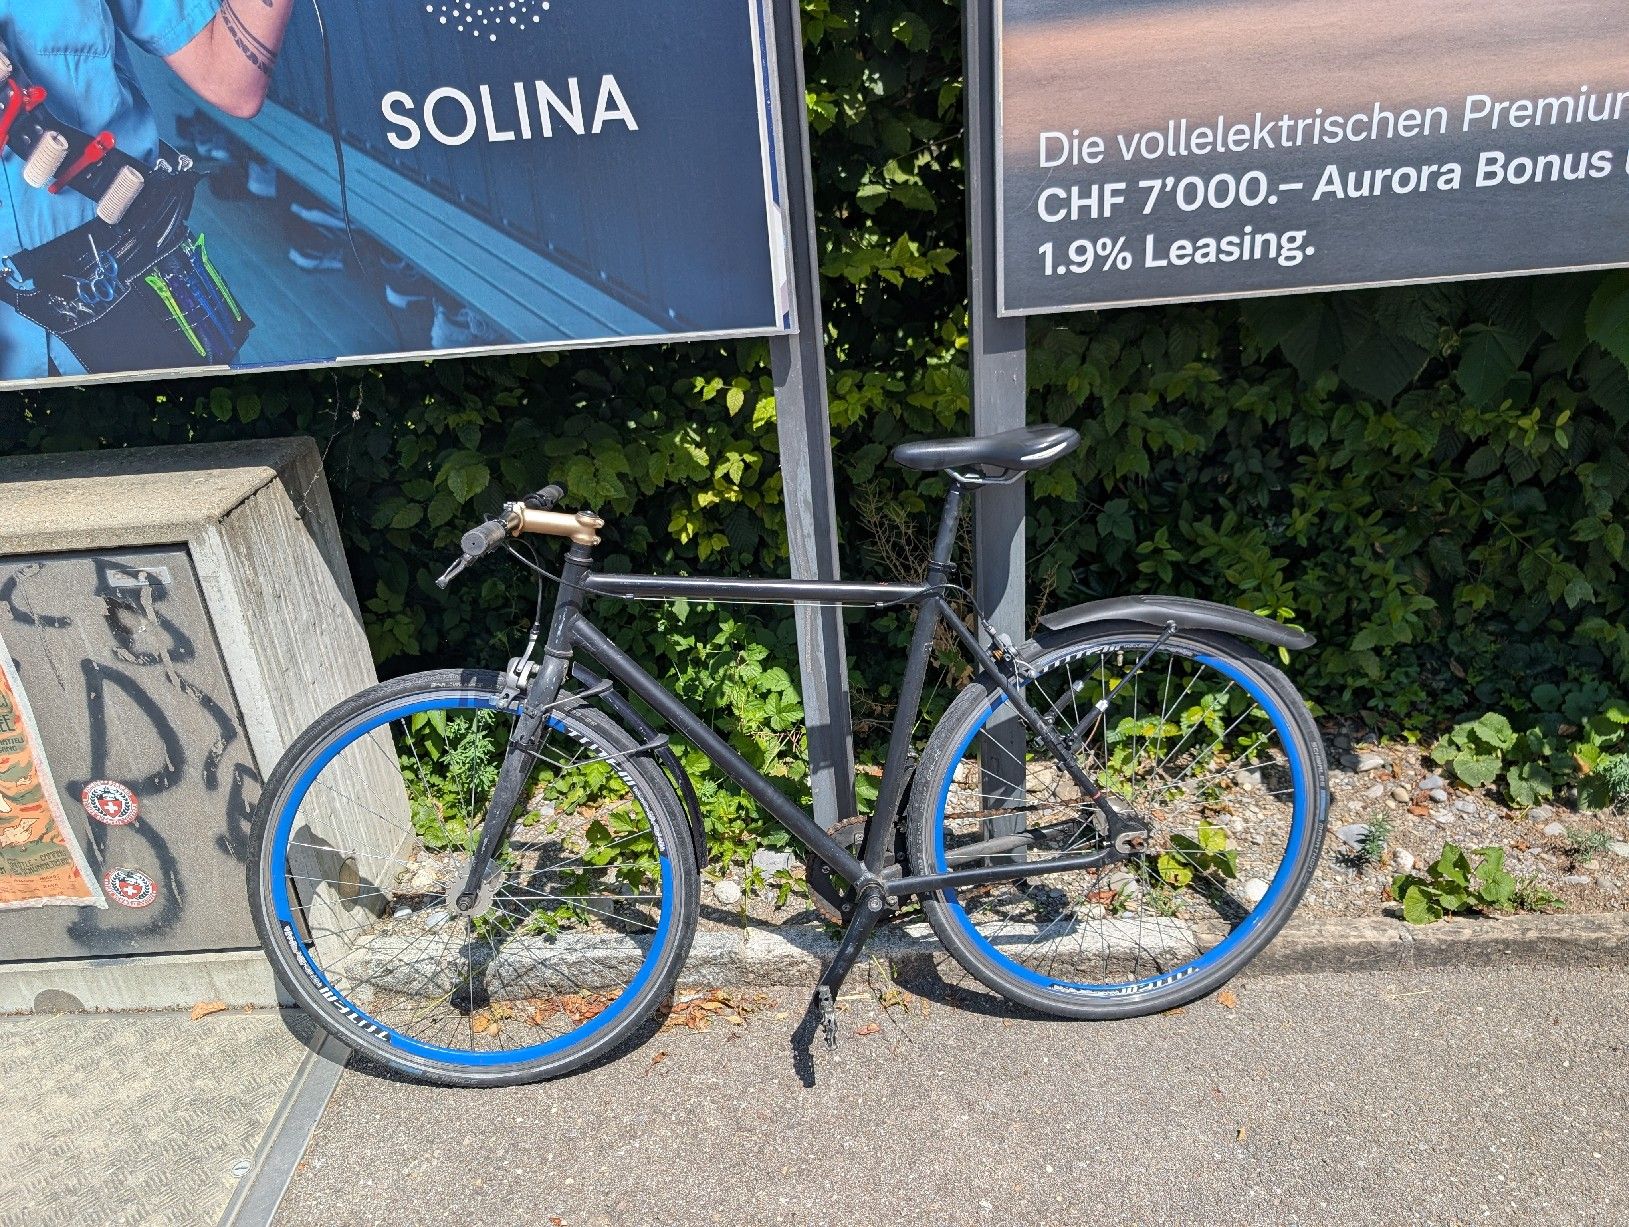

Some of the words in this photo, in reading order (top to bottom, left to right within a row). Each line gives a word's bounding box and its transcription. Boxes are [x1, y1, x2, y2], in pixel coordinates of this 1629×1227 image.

[381, 74, 639, 150] SOLINA
[1039, 128, 1105, 168] Die
[1117, 101, 1448, 161] vollelektrischen
[1037, 181, 1127, 223] CHF
[1311, 162, 1462, 201] Aurora
[1475, 149, 1614, 188] Bonus
[1037, 235, 1133, 276] 1.9%
[1144, 225, 1316, 267] Leasing.
